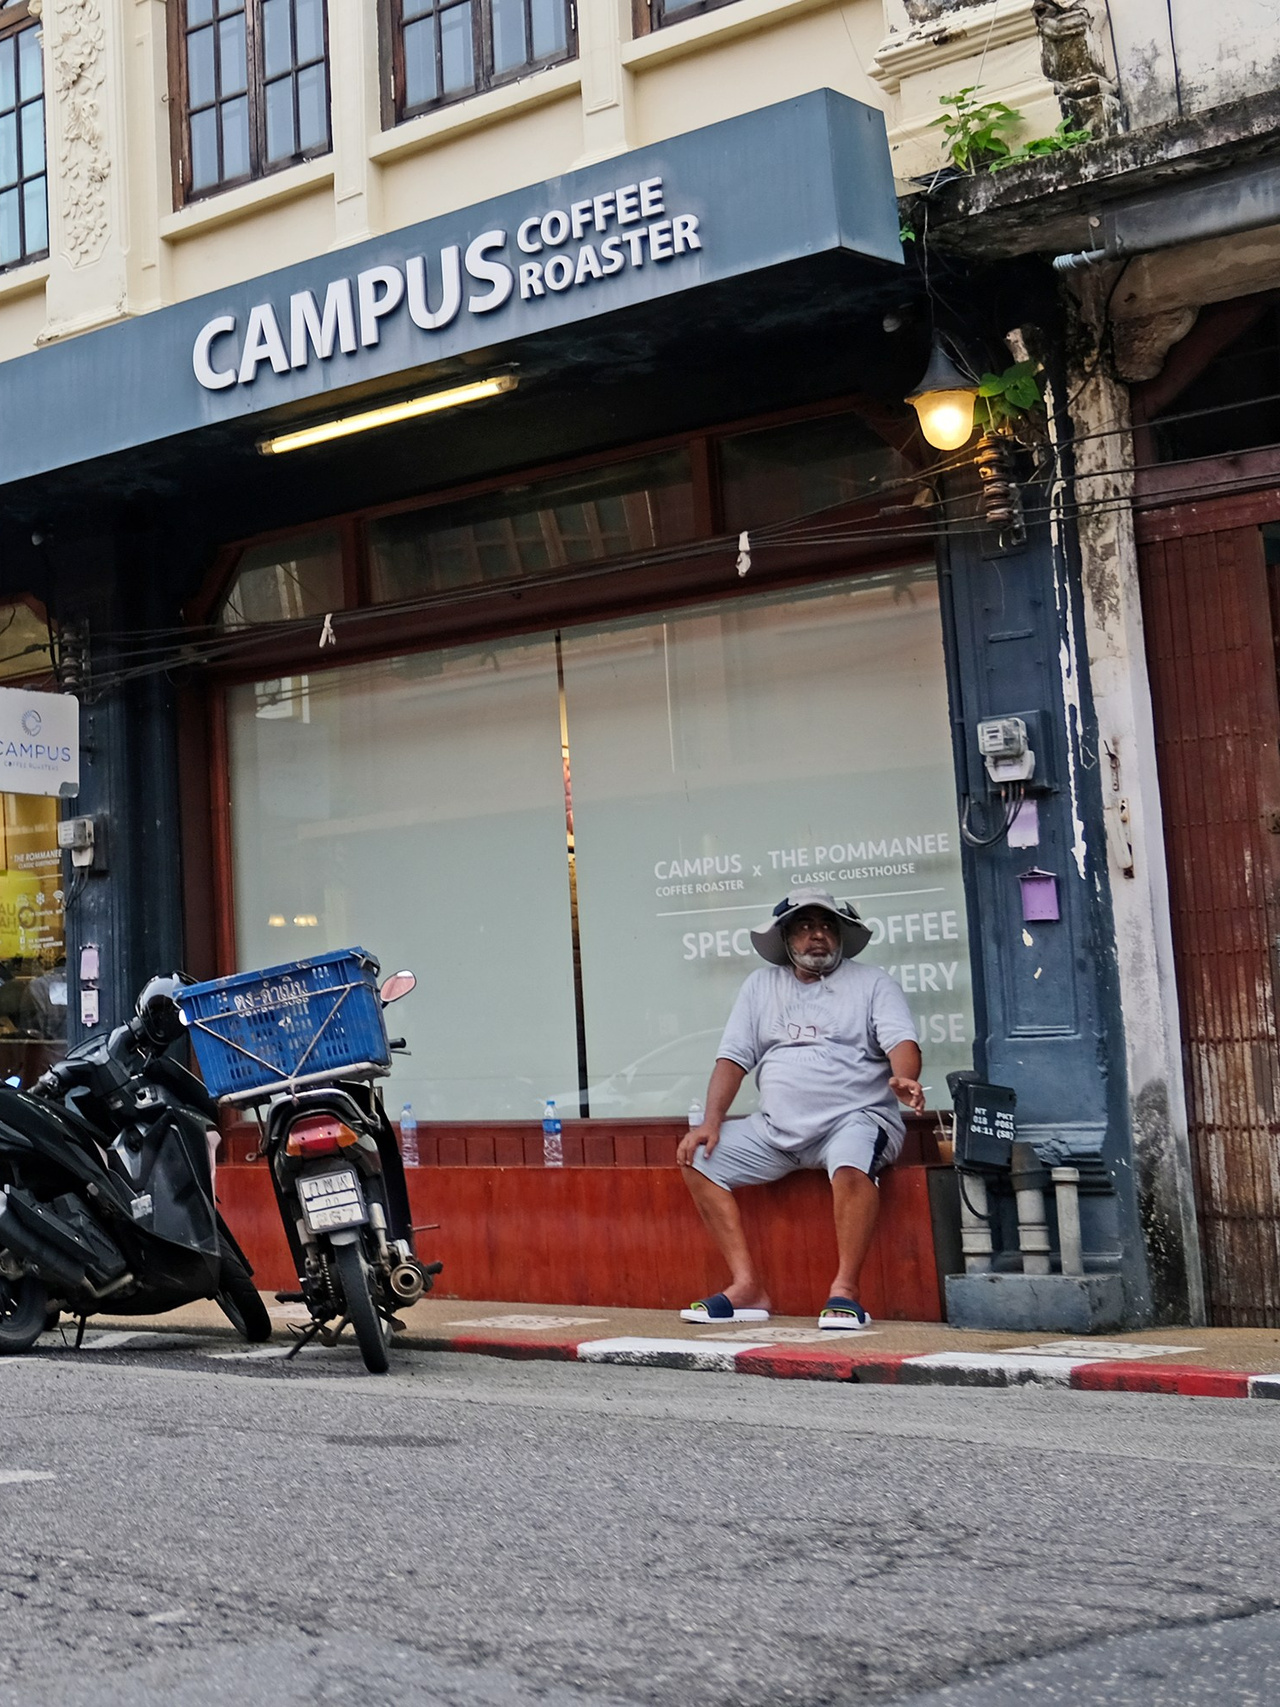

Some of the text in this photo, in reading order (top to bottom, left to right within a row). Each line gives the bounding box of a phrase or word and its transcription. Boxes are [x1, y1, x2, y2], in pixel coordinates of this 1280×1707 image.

[517, 176, 665, 254] COFFEE
[519, 213, 702, 301] ROASTER
[193, 229, 514, 390] CAMPUS
[654, 854, 742, 880] CAMPUS
[768, 848, 808, 870] THE
[791, 862, 915, 885] CLASSIC GUESTHOUSE
[655, 880, 744, 898] COFFEE ROASTER
[868, 910, 958, 945] OFFEE
[974, 1107, 987, 1115] NT
